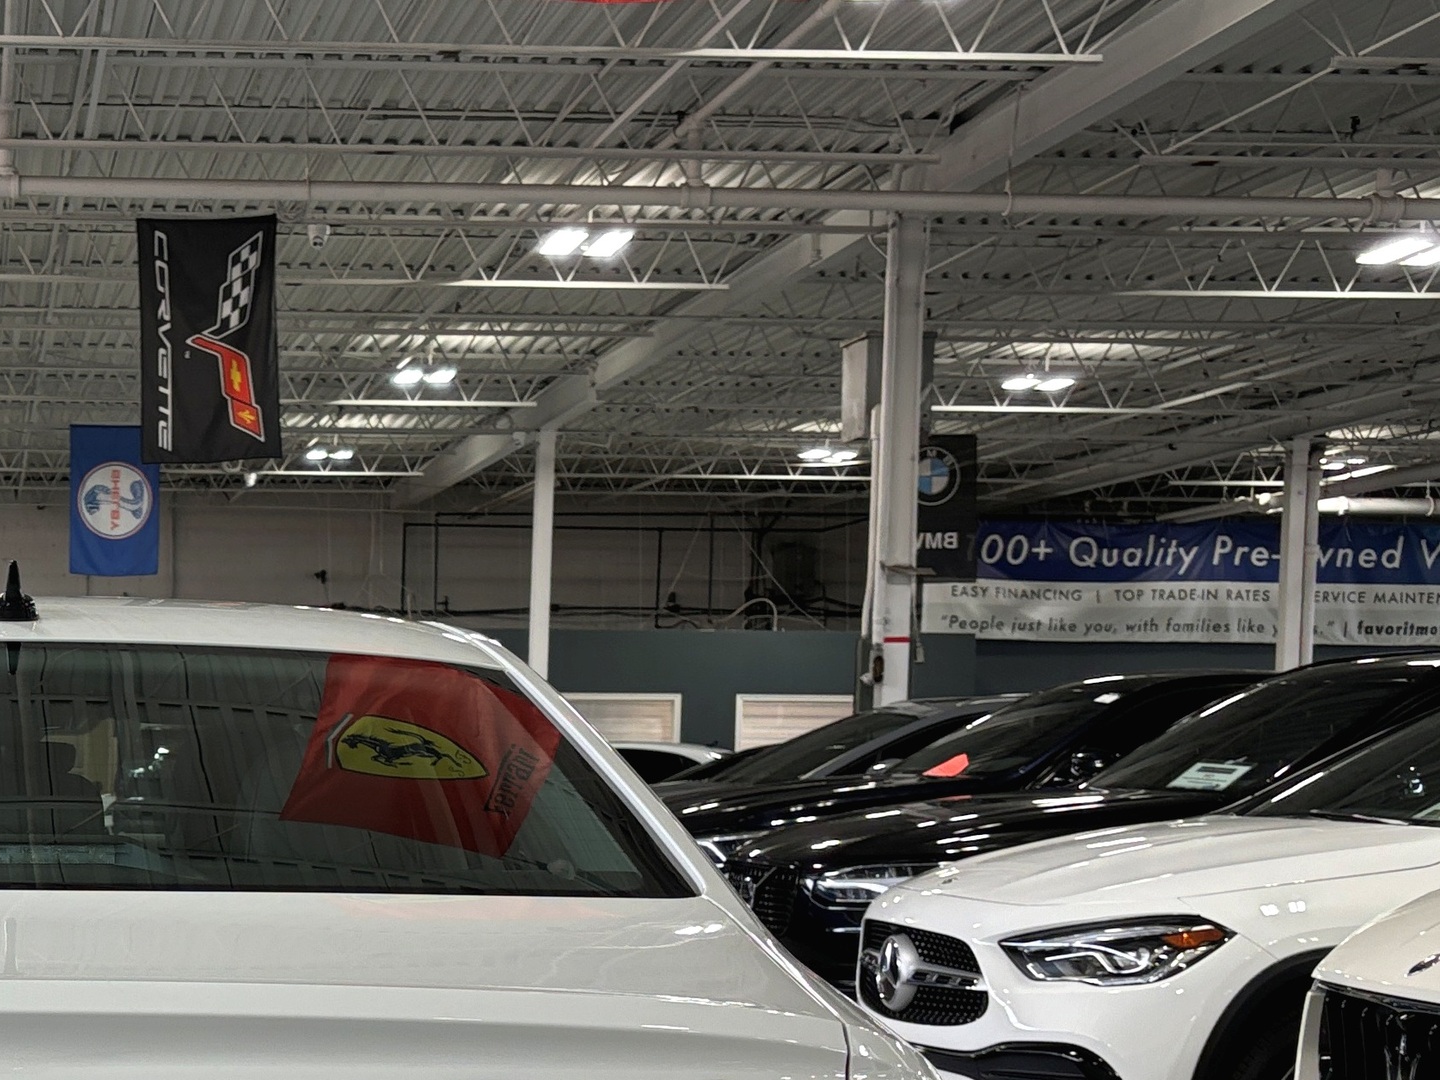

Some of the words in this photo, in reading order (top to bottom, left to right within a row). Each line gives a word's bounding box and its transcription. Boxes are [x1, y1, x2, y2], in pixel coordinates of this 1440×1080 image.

[154, 230, 173, 451] CORVETTE
[1069, 534, 1200, 575] Quality
[951, 585, 989, 599] EASY
[995, 586, 1083, 601] FINANCING
[1114, 588, 1144, 602] TOP
[1151, 588, 1219, 601] TRADE-IN
[1226, 589, 1271, 602] RATES
[1314, 590, 1367, 604] ERVICE
[1011, 617, 1042, 634] just
[1047, 617, 1077, 632] like
[1083, 621, 1117, 636] you,
[1126, 617, 1159, 633] with
[1166, 617, 1231, 633] families
[1237, 617, 1265, 633] like
